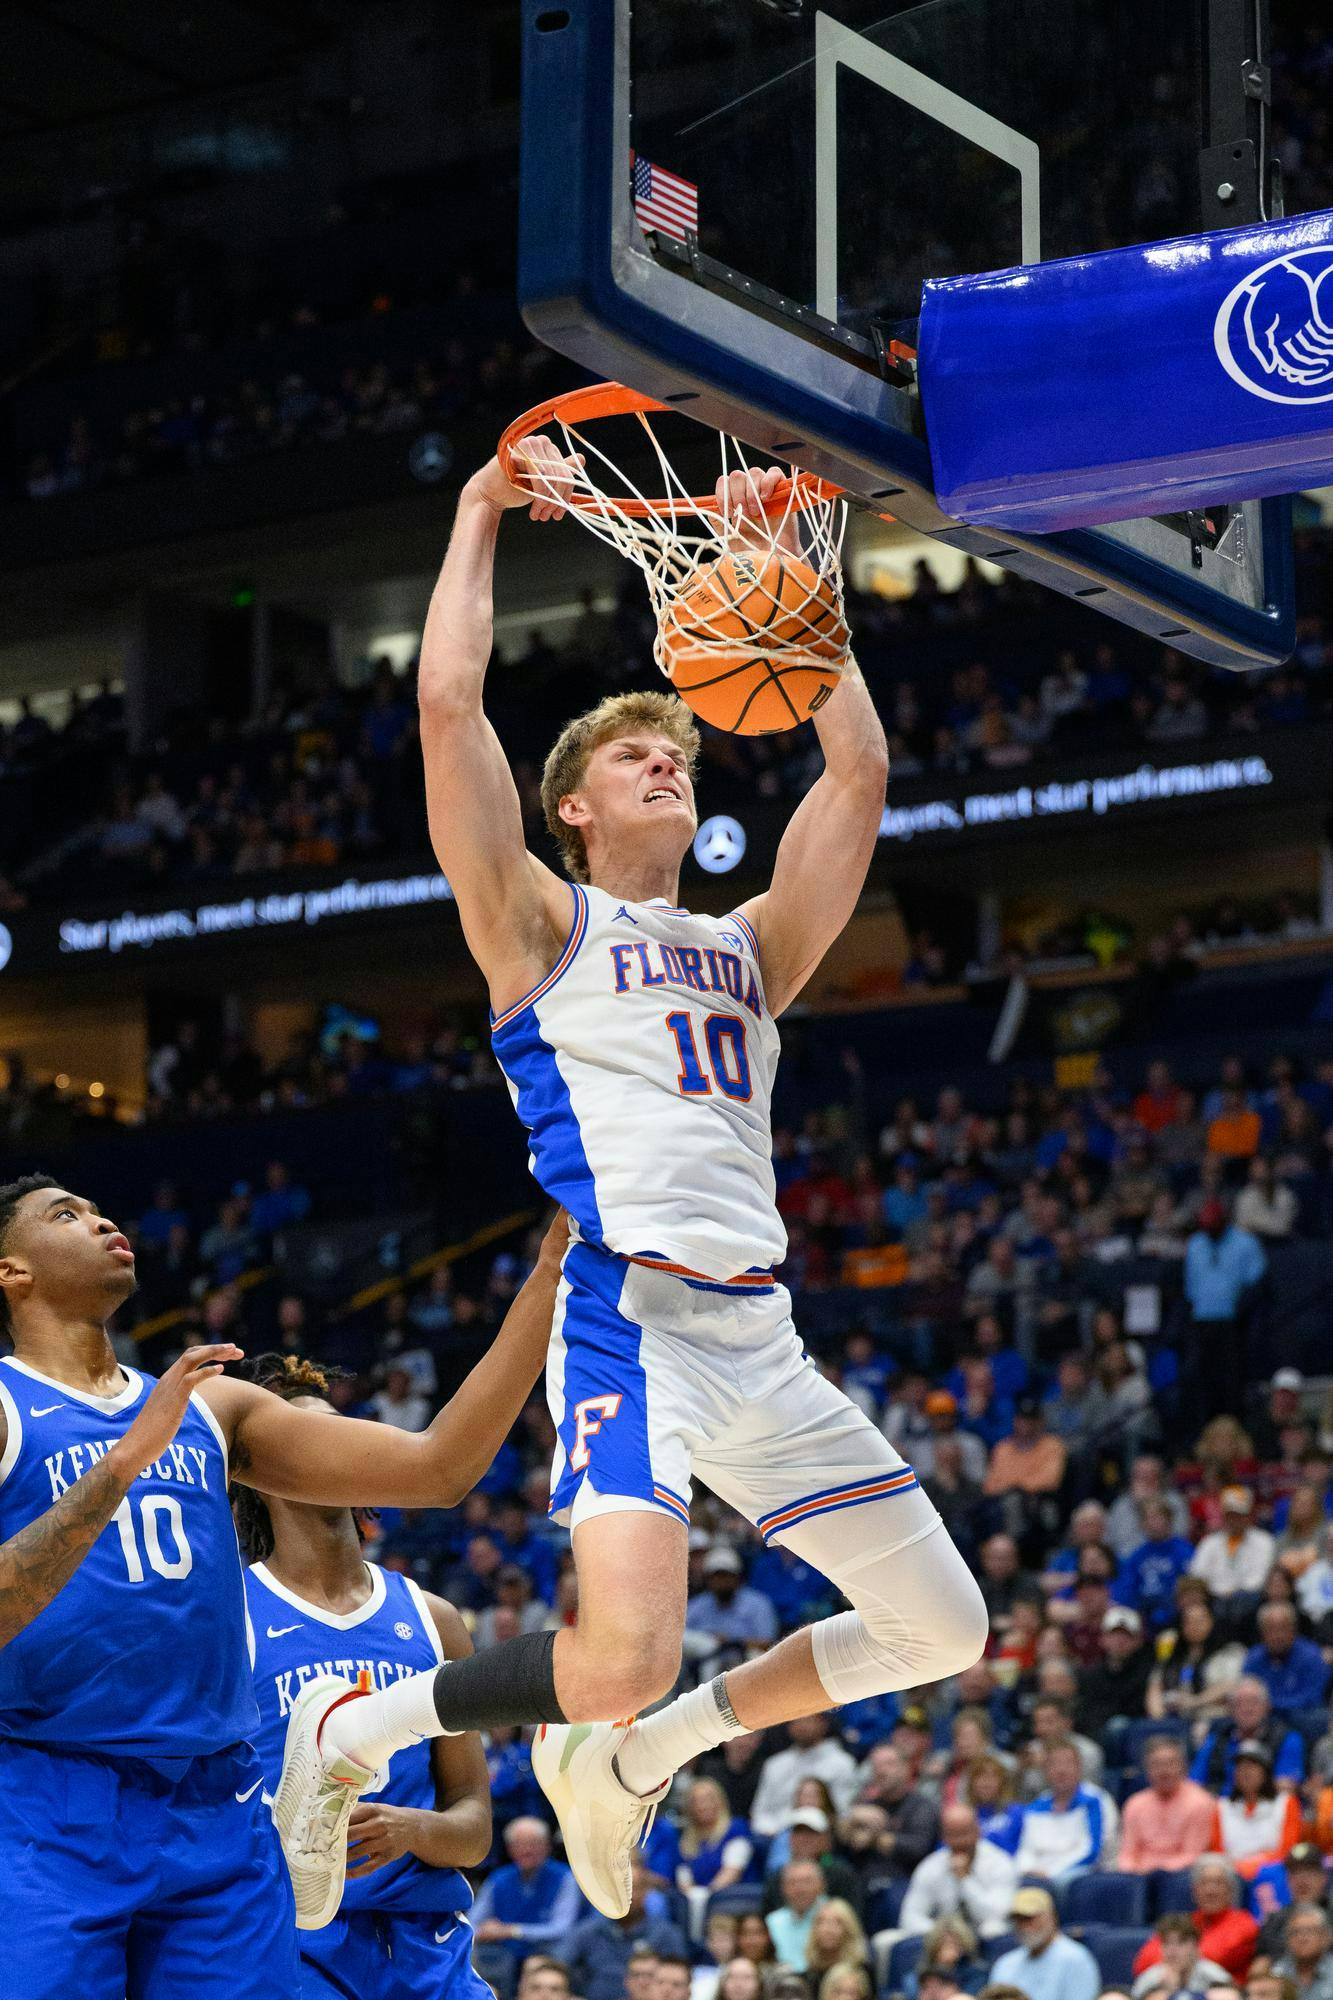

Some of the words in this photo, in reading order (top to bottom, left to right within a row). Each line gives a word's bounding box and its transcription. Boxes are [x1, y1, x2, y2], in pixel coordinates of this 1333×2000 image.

[965, 787, 1032, 825] meet
[1034, 780, 1089, 815] star
[1092, 755, 1273, 814] performance.
[59, 917, 108, 952] Star
[108, 909, 197, 953] players,
[196, 898, 254, 934] meet
[254, 893, 304, 925] star
[610, 940, 762, 1021] FLORIDA
[665, 1010, 754, 1103] 10
[44, 1439, 208, 1503] KENCKY
[569, 1392, 623, 1473] F
[110, 1494, 193, 1583] 10
